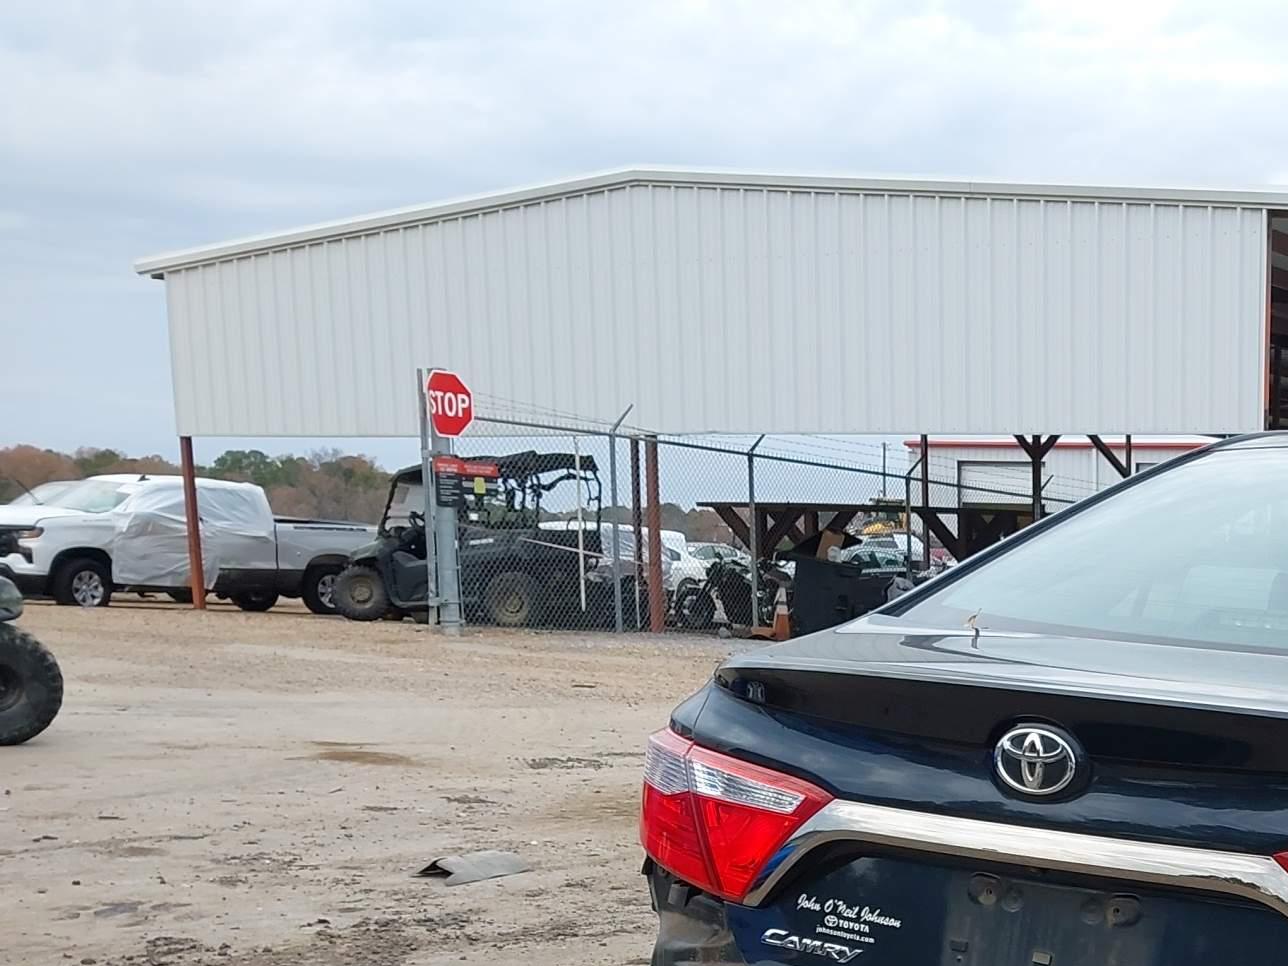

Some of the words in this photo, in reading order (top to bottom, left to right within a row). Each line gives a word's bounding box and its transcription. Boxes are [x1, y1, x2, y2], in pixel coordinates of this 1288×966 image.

[429, 390, 470, 417] STOP
[797, 893, 822, 911] John
[860, 907, 902, 929] Johnson
[838, 919, 870, 933] TOYOTA
[760, 928, 864, 963] CAMRY
